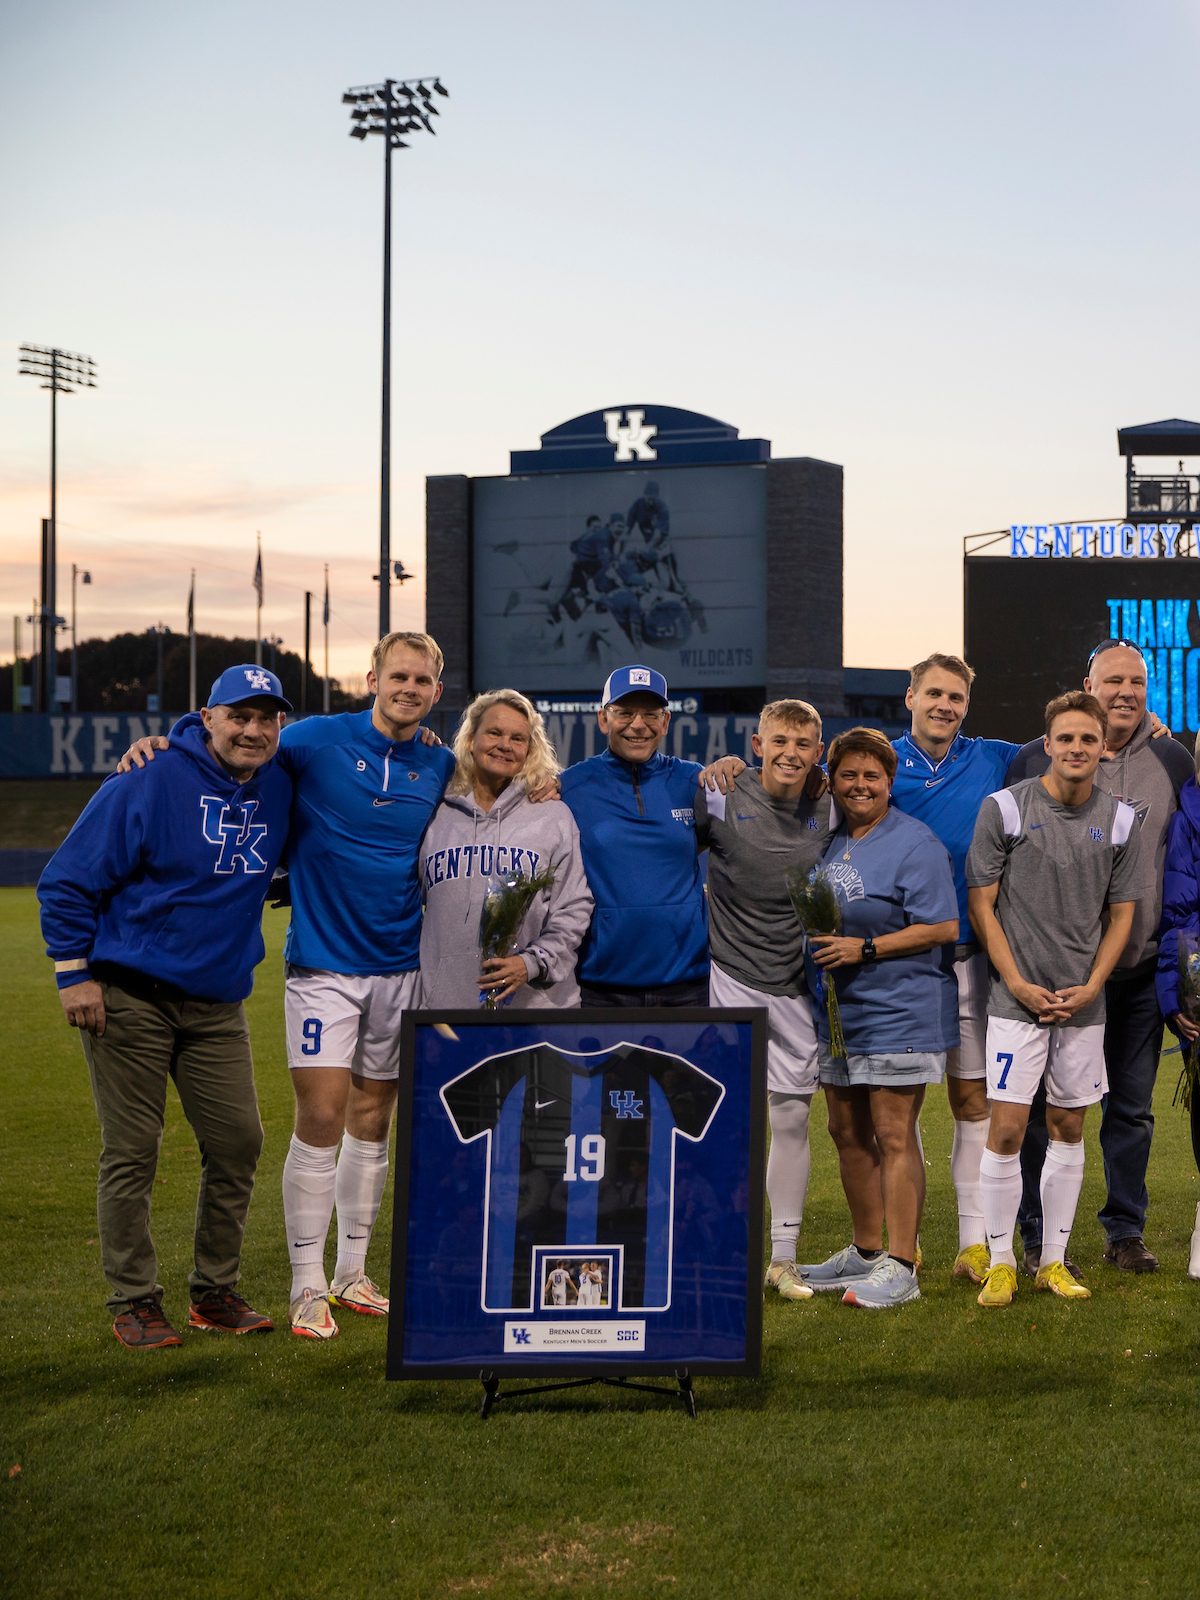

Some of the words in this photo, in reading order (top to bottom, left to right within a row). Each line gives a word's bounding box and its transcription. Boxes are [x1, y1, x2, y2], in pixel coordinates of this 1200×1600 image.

[603, 409, 658, 462] UK
[1009, 523, 1181, 559] KENTUCKY
[1106, 598, 1192, 648] THANK
[679, 648, 754, 668] WILDCATS
[244, 669, 272, 692] UK
[552, 702, 604, 713] KENTUCK
[356, 760, 367, 772] 9
[905, 758, 914, 768] 4
[200, 795, 268, 874] UK
[806, 816, 819, 830] UK
[1089, 826, 1104, 842] UK
[425, 844, 541, 891] KENTUCKY
[301, 1018, 323, 1056] 9
[996, 1052, 1014, 1090] 7
[609, 1090, 644, 1118] UK
[563, 1134, 606, 1182] 19
[512, 1328, 532, 1344] UK
[581, 1327, 602, 1335] CREEK
